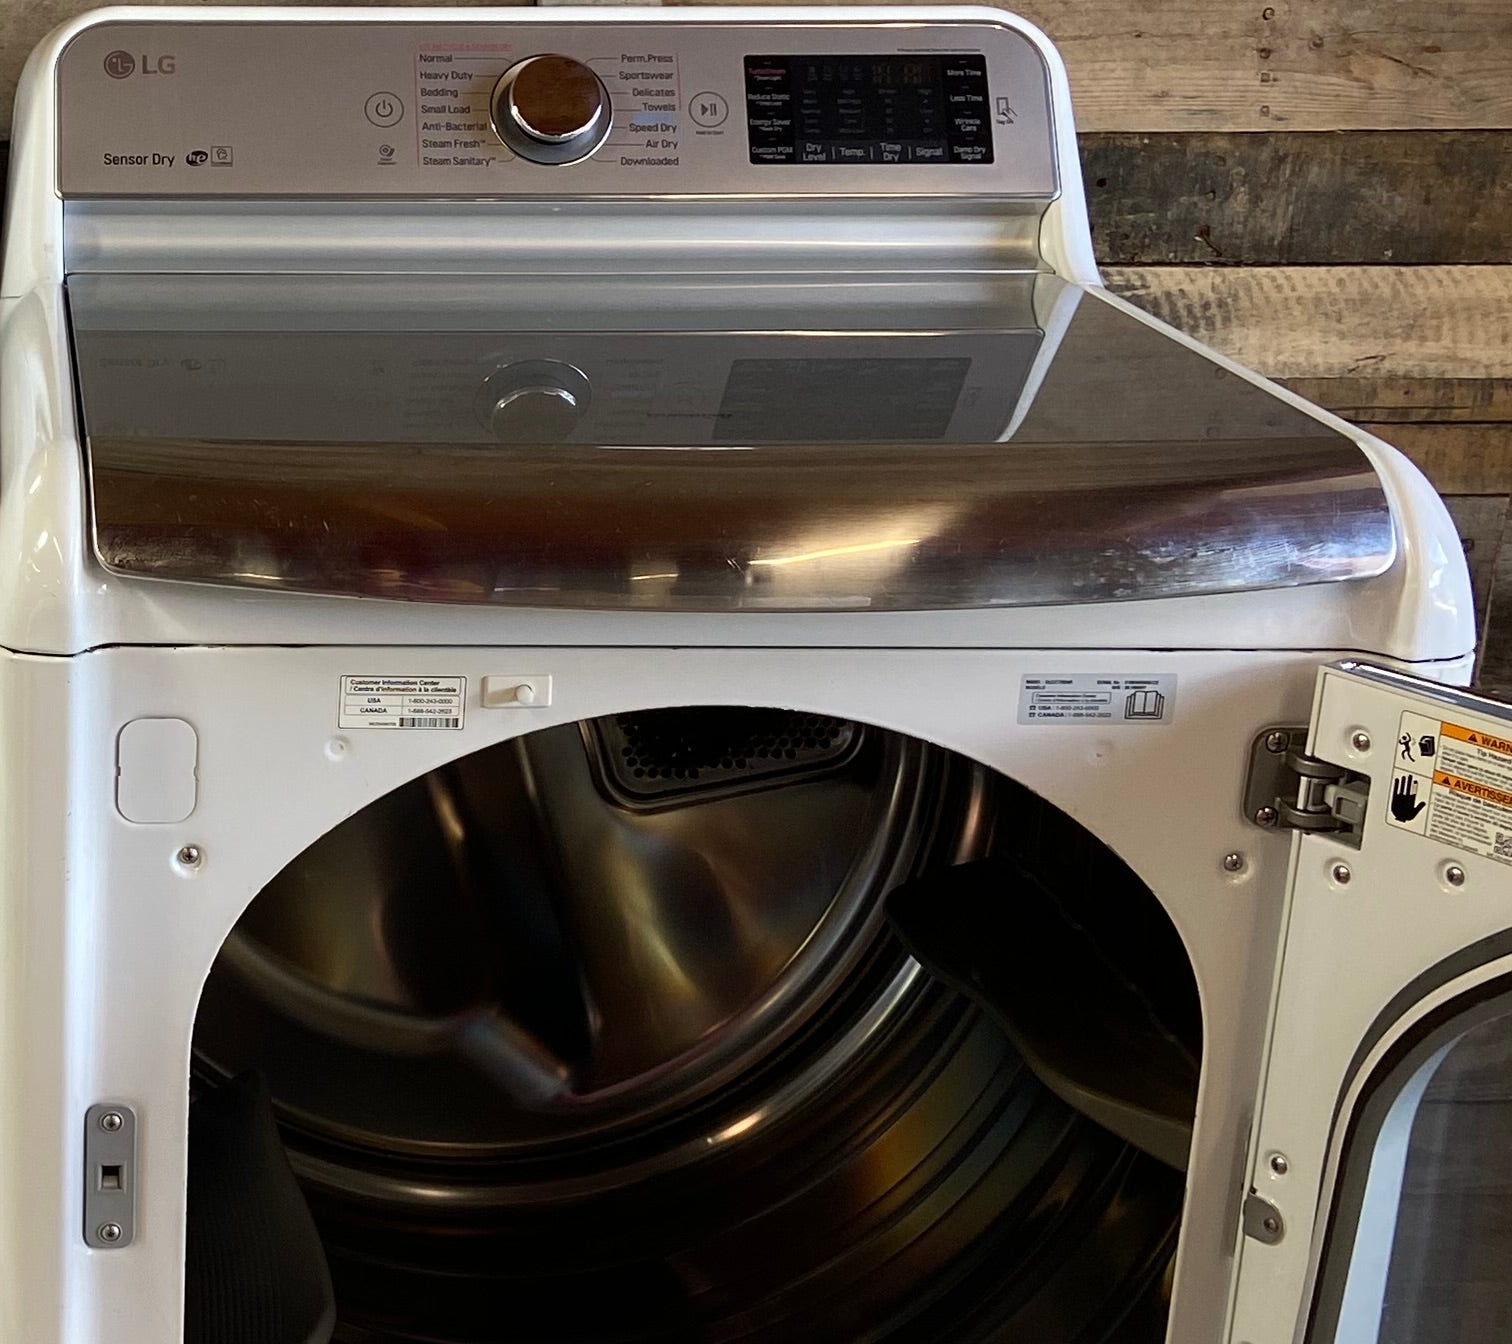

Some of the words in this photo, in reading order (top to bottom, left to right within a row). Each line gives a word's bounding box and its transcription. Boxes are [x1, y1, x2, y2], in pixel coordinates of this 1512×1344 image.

[420, 54, 453, 63] Normal
[141, 54, 176, 75] LG
[420, 71, 448, 81] Heavy
[451, 71, 473, 81] Duty
[619, 71, 673, 81] Sportswear
[421, 88, 458, 98] Bedding
[632, 88, 675, 97] Delicates
[949, 94, 966, 102] Less
[966, 94, 983, 102] Time
[421, 105, 445, 114] Small
[446, 105, 470, 114] Load
[642, 103, 676, 112] Towels
[422, 122, 487, 131] Anti-Bacterial
[629, 123, 659, 133] Speed
[660, 123, 678, 133] Dry
[422, 139, 452, 148] Steam
[645, 139, 659, 150] Air
[661, 139, 679, 150] Dry
[806, 143, 822, 153] Dry
[880, 142, 901, 151] Time
[803, 153, 826, 161] Level
[883, 152, 900, 162] Dry
[915, 147, 943, 157] Signal
[104, 153, 149, 166] Sensor
[152, 153, 175, 167] Dry
[423, 157, 451, 167] Steam
[620, 157, 679, 166] Downloaded
[1454, 780, 1512, 805] AVERTISSE
